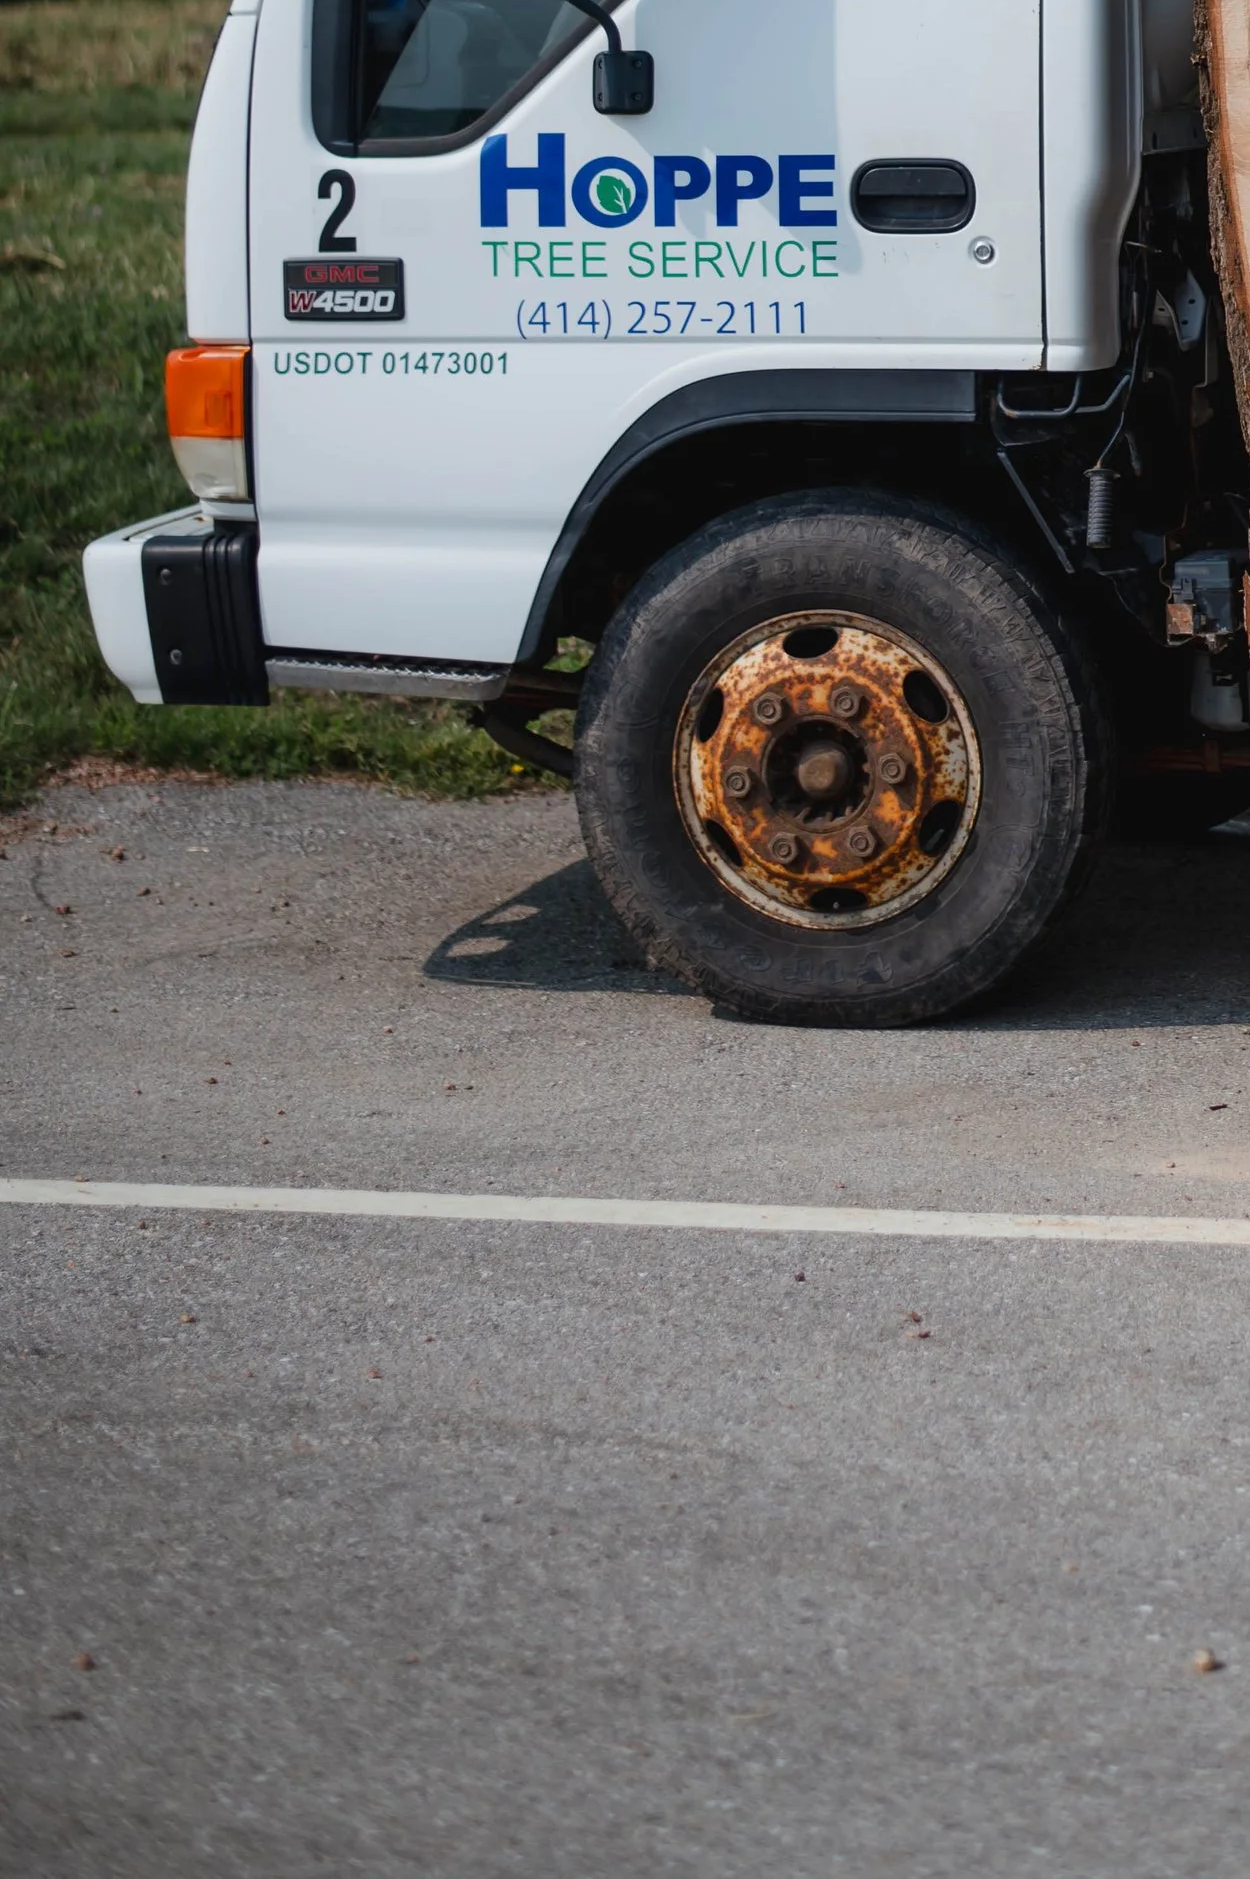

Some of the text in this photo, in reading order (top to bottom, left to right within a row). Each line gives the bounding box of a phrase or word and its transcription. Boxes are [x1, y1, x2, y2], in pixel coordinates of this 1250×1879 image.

[480, 133, 838, 229] HOPPE
[317, 168, 357, 253] 2
[304, 265, 380, 283] GMC
[482, 240, 839, 279] TREE SERVICE
[288, 288, 395, 313] W4500
[516, 299, 809, 341] (414) 257-2111
[273, 352, 509, 375] USDOT 01473001
